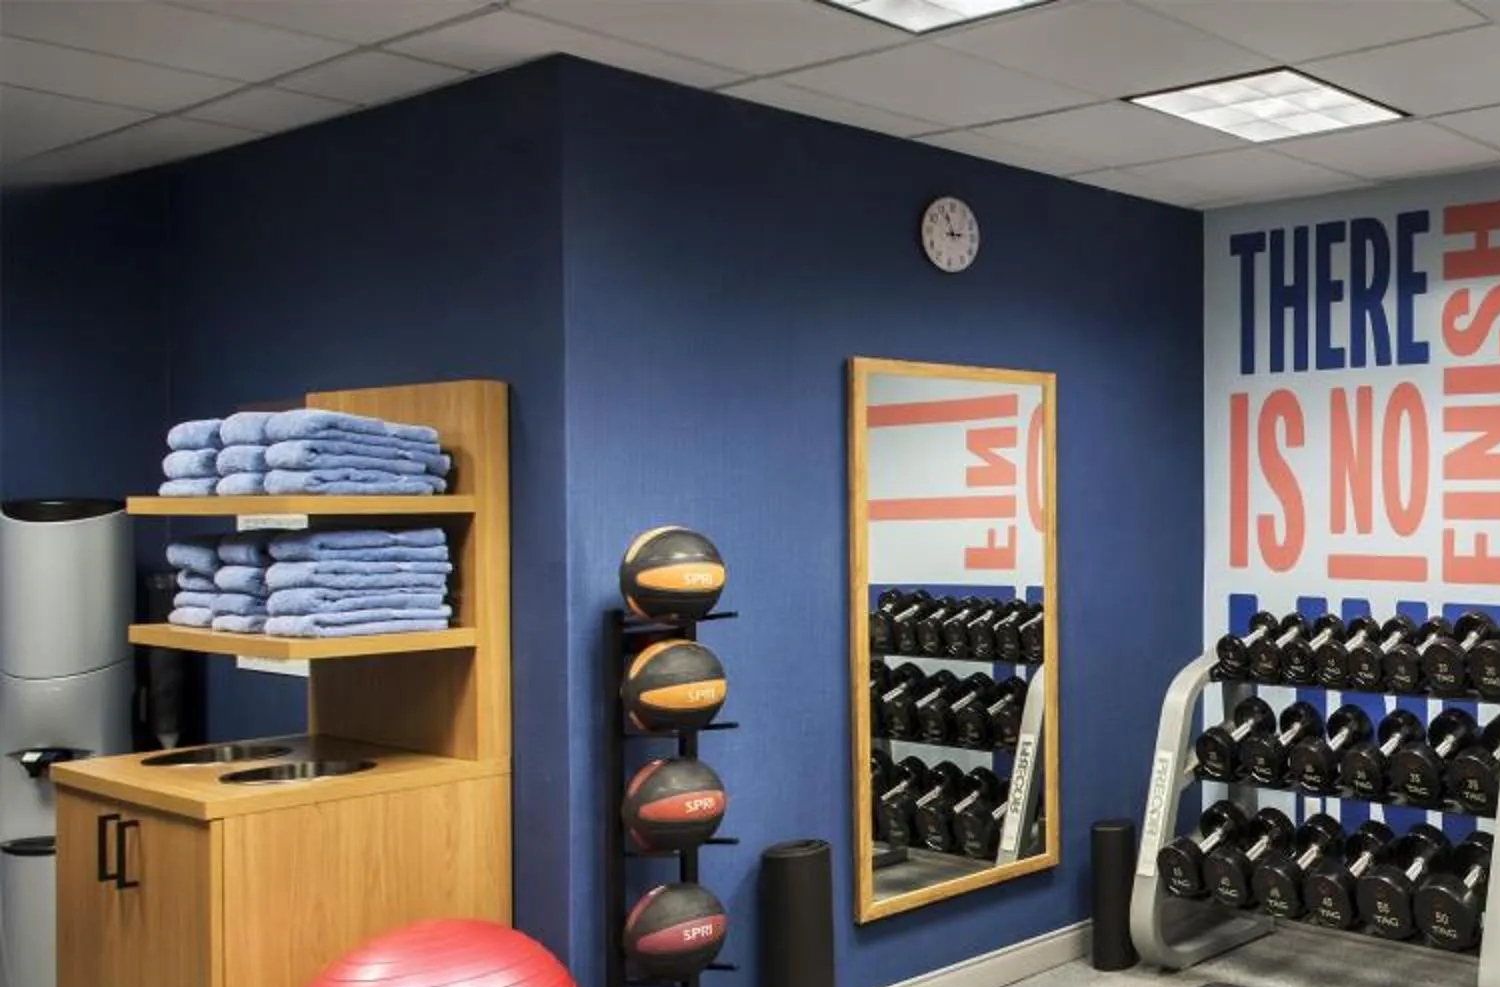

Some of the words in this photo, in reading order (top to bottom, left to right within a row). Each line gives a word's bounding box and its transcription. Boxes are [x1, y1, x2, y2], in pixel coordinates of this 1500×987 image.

[1230, 209, 1430, 376] THERE
[1229, 388, 1306, 573] IS
[1329, 381, 1430, 538] NO
[684, 572, 713, 588] SPRI
[685, 797, 716, 815] SPRI
[1374, 914, 1400, 928] TAG
[1434, 911, 1450, 925] 50
[683, 924, 713, 941] SPRI
